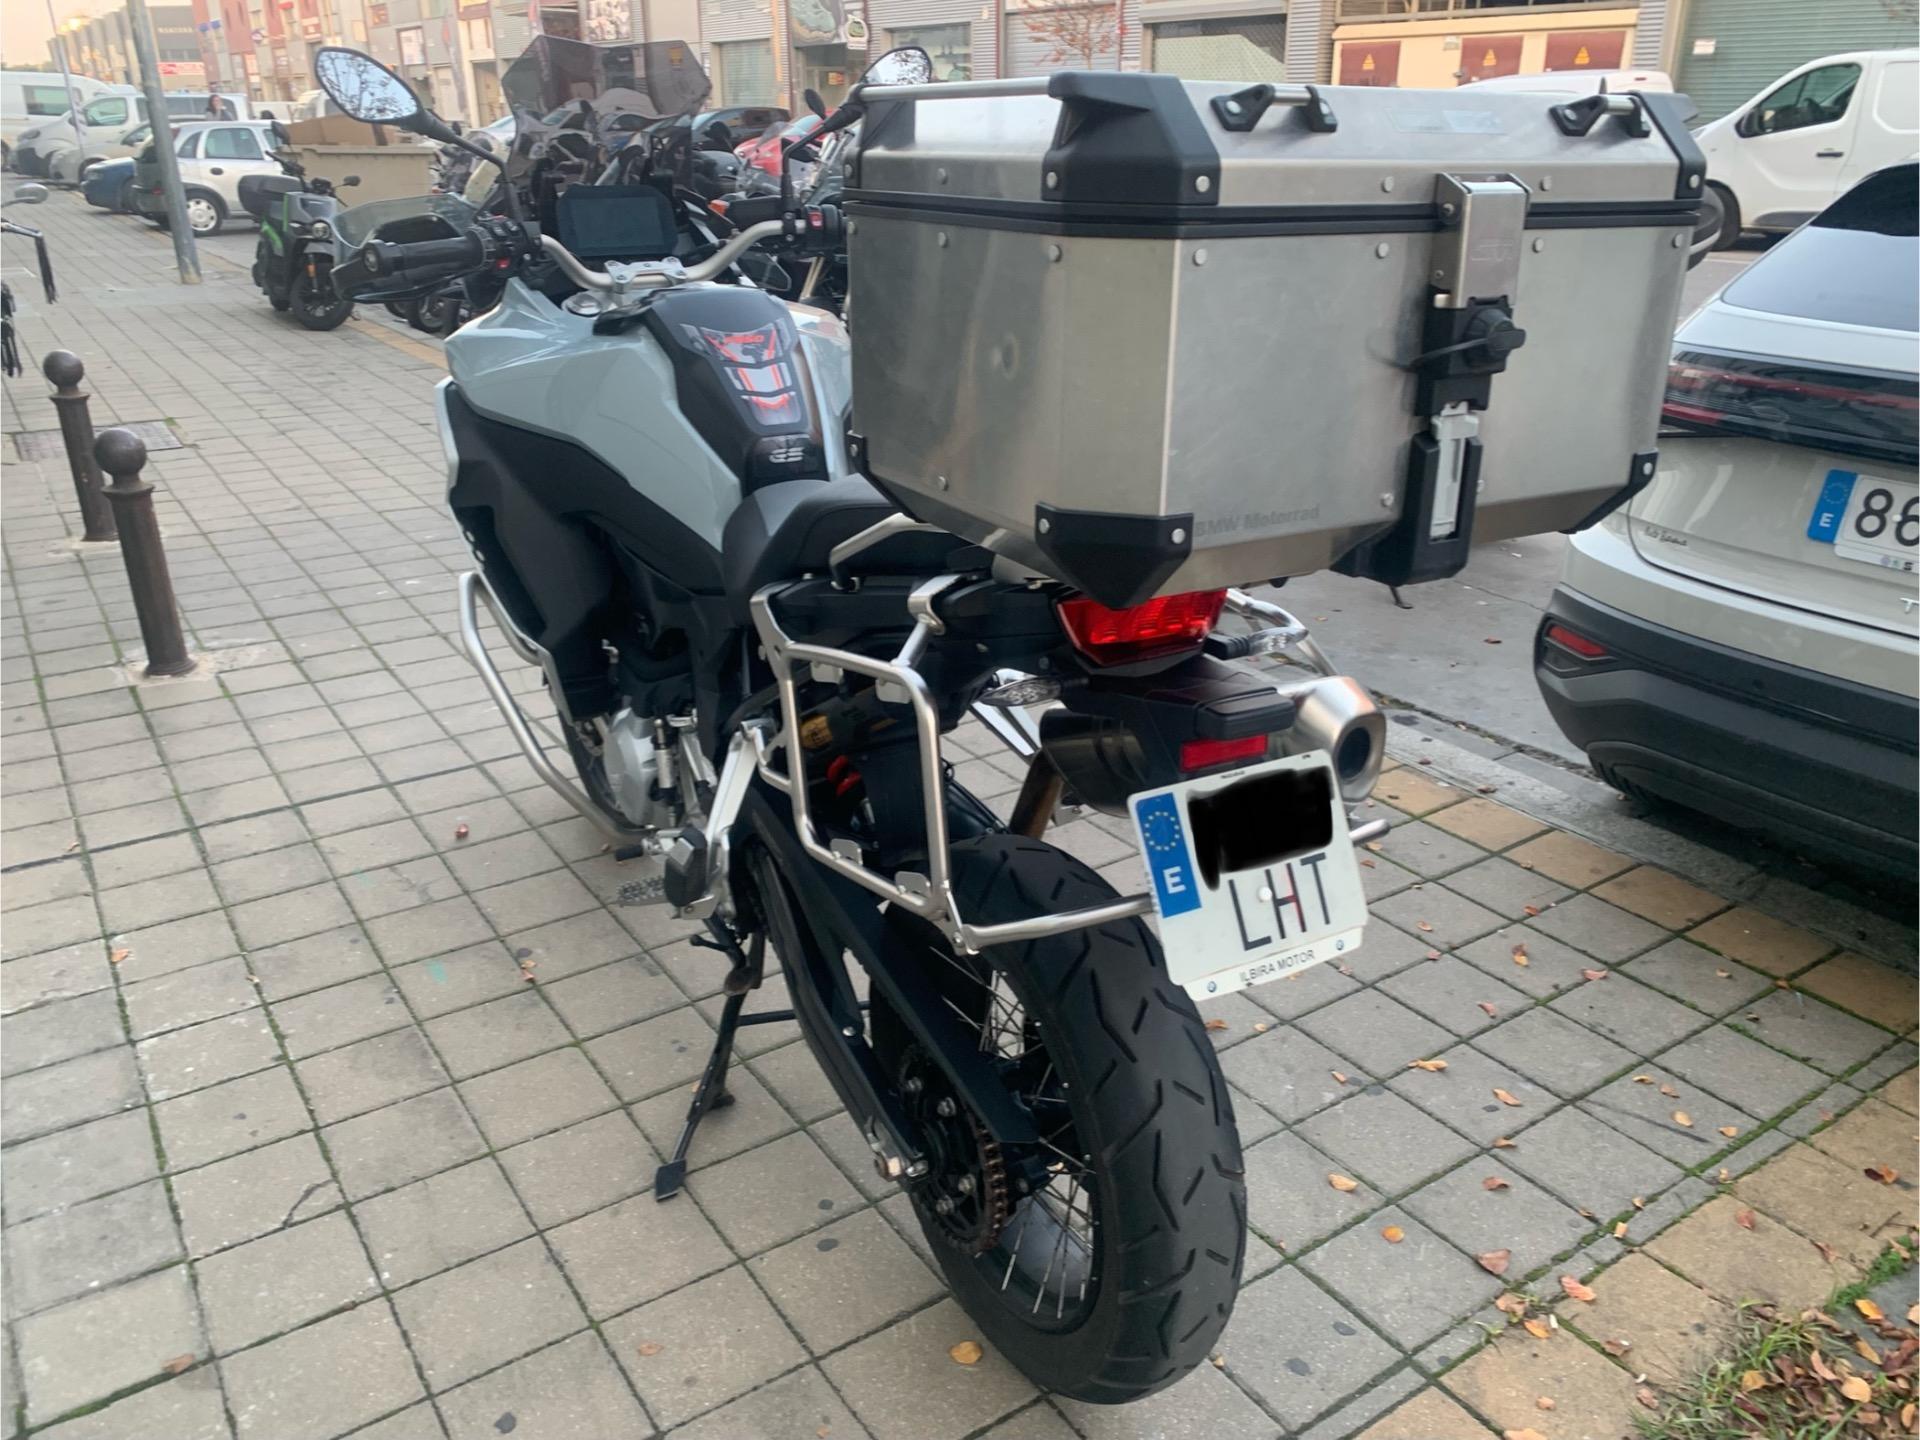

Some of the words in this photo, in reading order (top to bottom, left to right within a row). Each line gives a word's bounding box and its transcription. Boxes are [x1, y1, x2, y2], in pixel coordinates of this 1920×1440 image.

[769, 447, 804, 463] GS
[1195, 514, 1240, 537] BMW
[1246, 504, 1319, 528] Motorrad
[1820, 513, 1834, 527] E
[1164, 867, 1185, 893] E
[1228, 852, 1331, 951] LHT
[1239, 963, 1276, 982] ILBIRA
[1277, 950, 1315, 970] MOTOR
